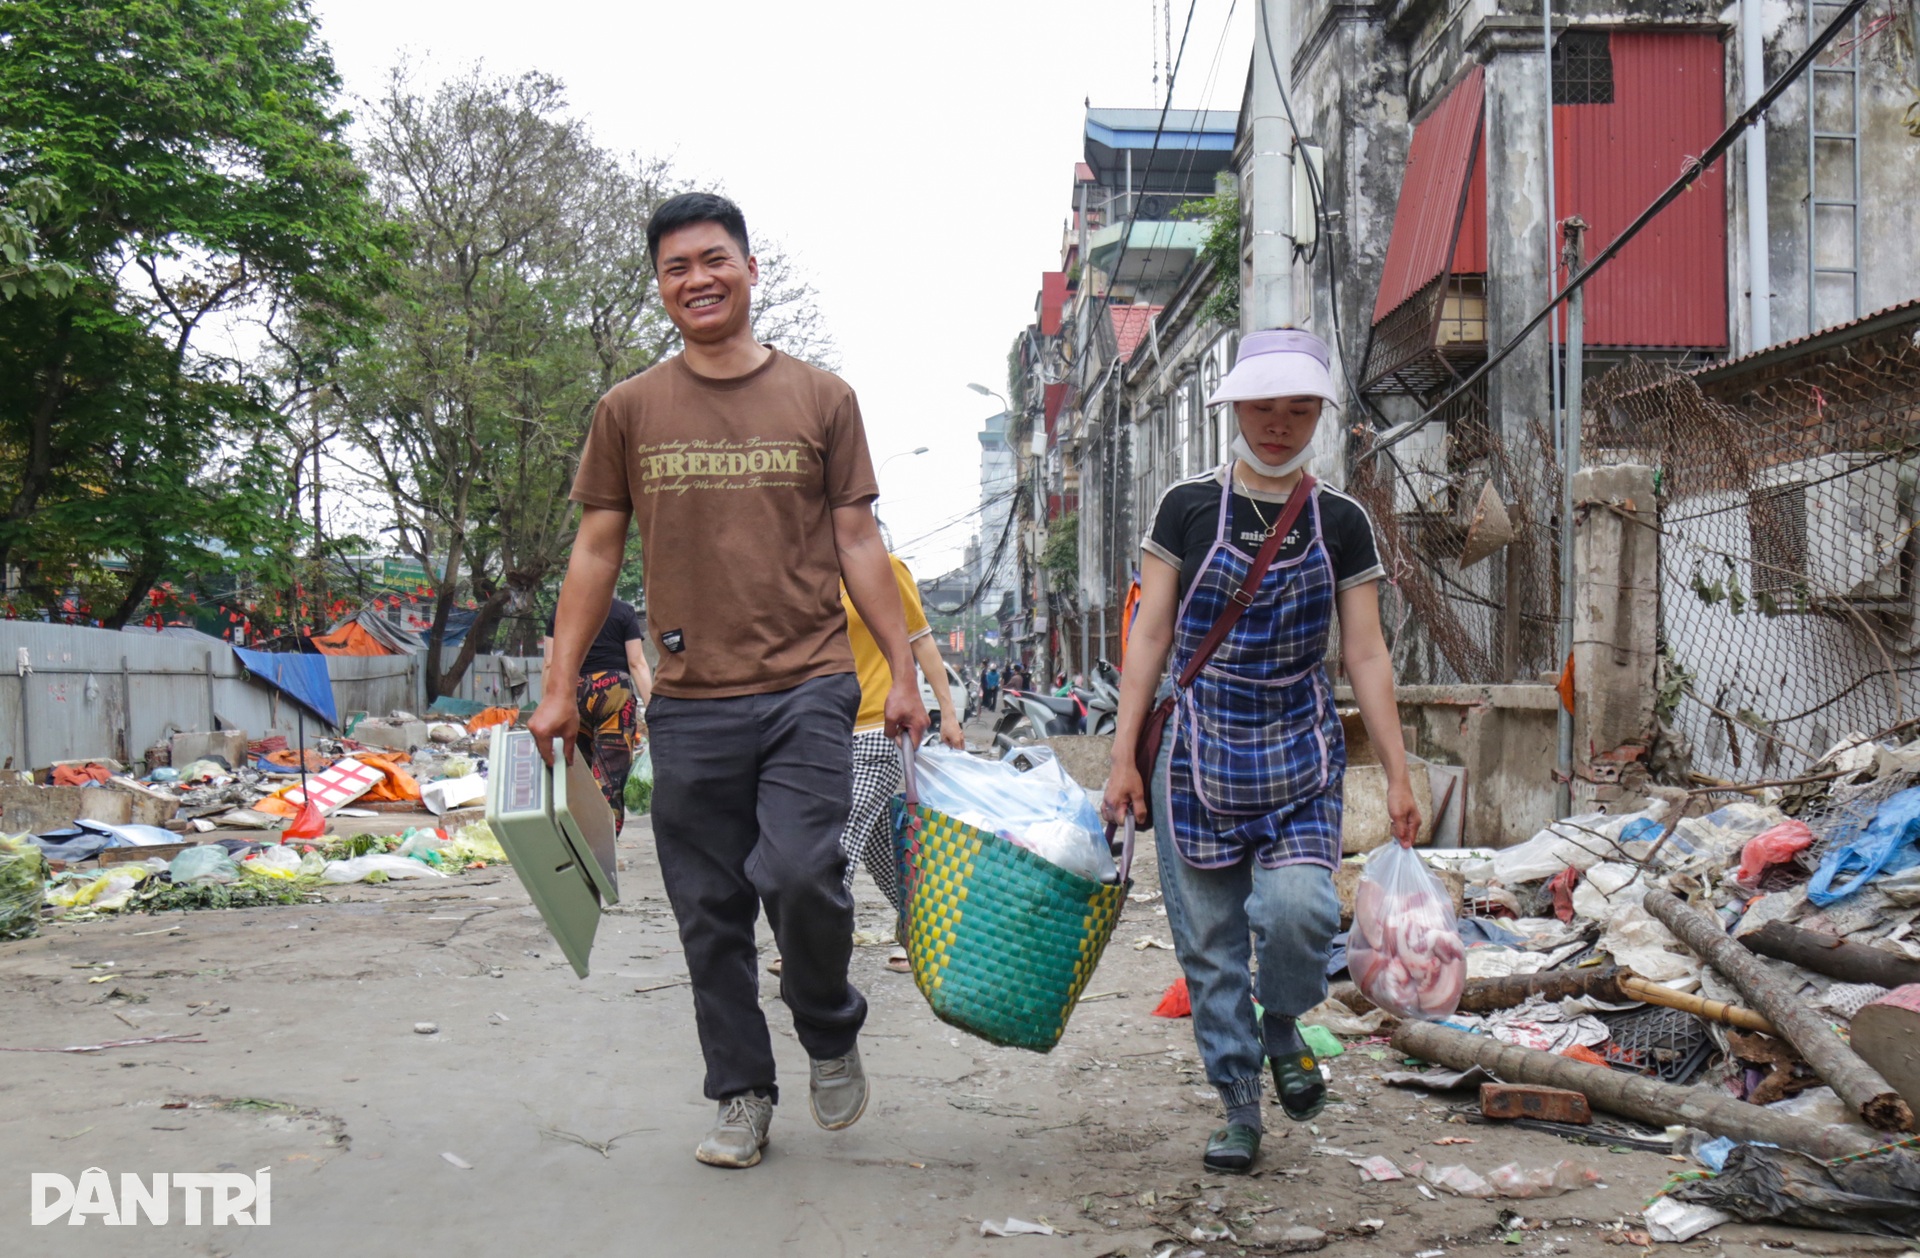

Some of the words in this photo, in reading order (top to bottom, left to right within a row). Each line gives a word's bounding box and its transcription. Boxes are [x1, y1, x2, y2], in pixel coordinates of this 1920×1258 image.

[660, 439, 690, 454] today
[691, 439, 726, 450] Worth
[726, 442, 743, 450] two
[648, 449, 799, 479] FREEDOM
